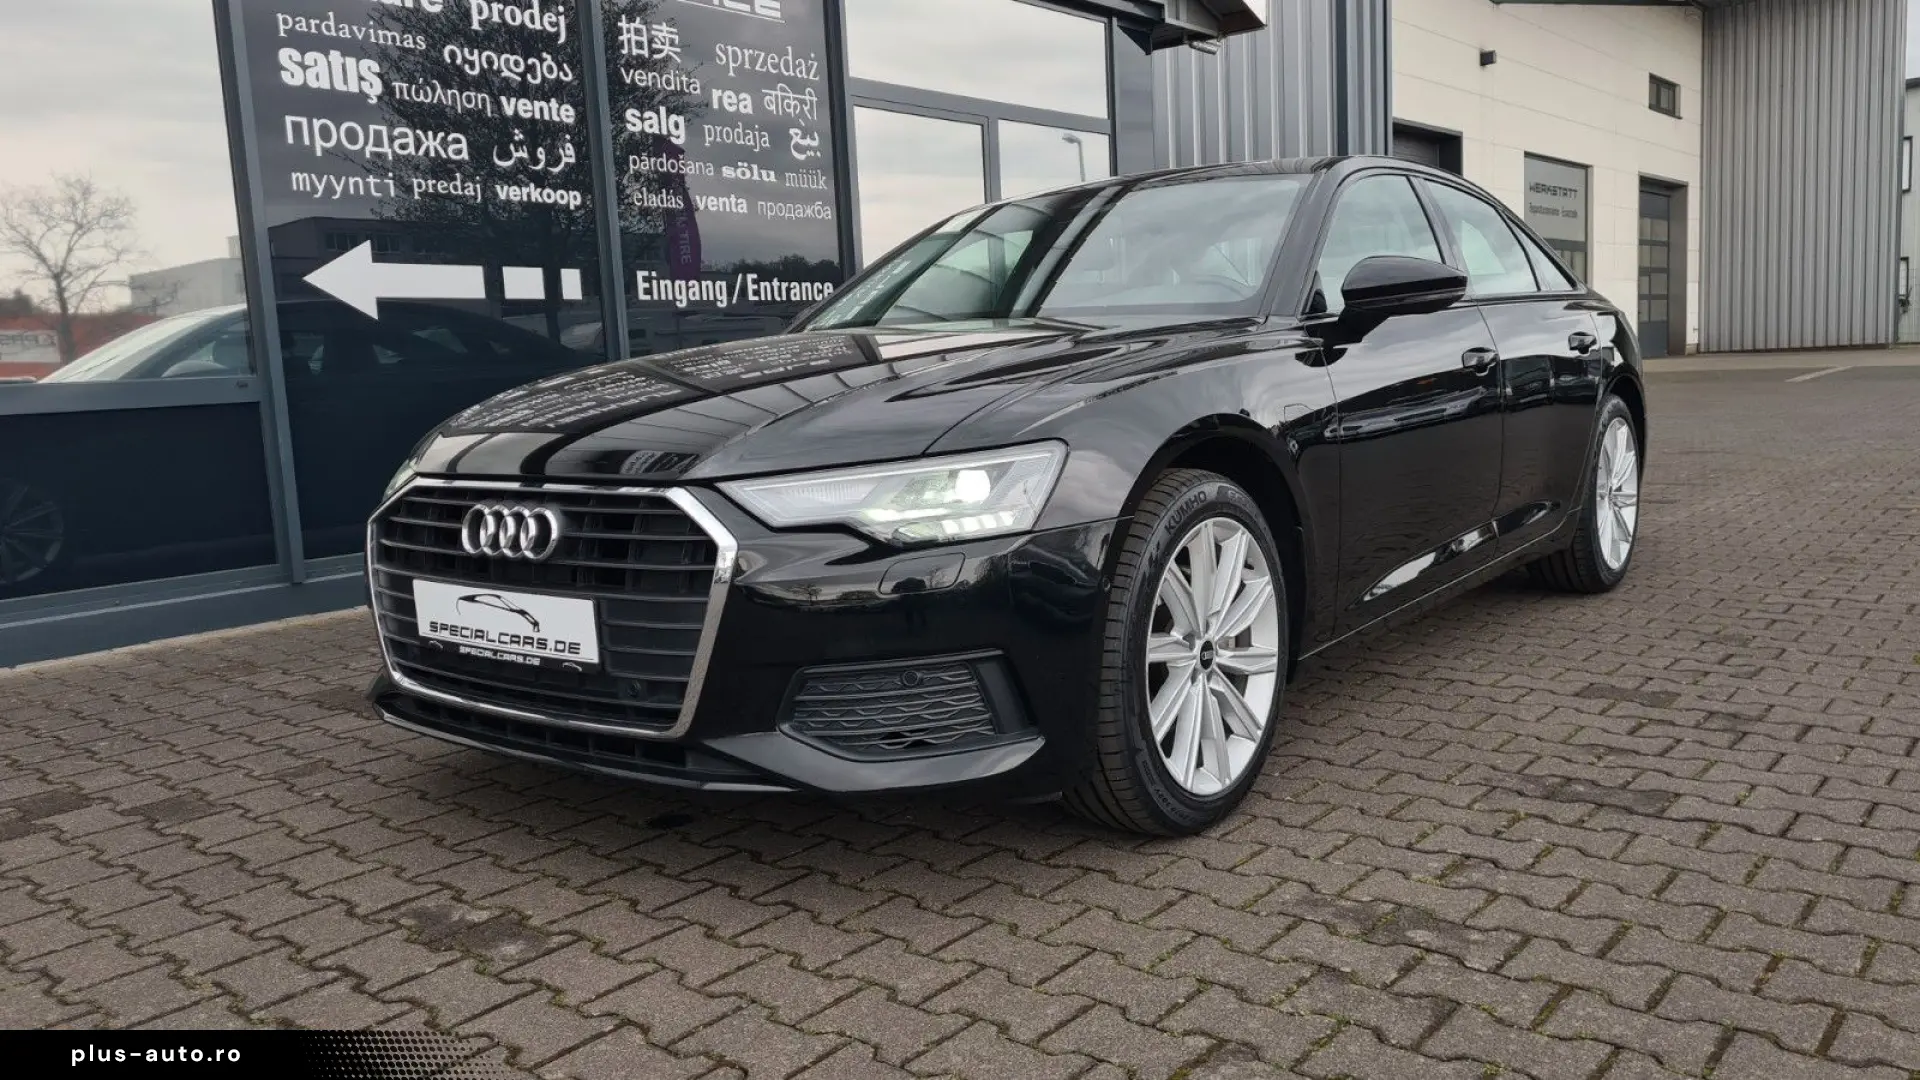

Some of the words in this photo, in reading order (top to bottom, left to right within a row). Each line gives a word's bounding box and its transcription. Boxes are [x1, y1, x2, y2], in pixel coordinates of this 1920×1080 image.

[276, 12, 426, 50] pardavimas
[471, 0, 566, 44] prodej
[617, 14, 682, 63] 拍卖
[278, 47, 383, 104] satış
[715, 42, 820, 81] sprzedaż
[620, 67, 701, 95] vendita
[391, 77, 492, 117] πώληση
[499, 96, 576, 124] vente
[712, 87, 753, 114] rea
[284, 115, 469, 160] продажа
[624, 106, 686, 145] salg
[703, 122, 771, 152] prodaja
[492, 128, 576, 172] فروش
[629, 152, 714, 177] pārdošana
[291, 171, 395, 199] myynti
[721, 162, 777, 182] sölu
[785, 169, 828, 190] müük
[412, 174, 482, 203] predaj
[496, 184, 582, 209] verkoop
[633, 187, 684, 209] eladás
[696, 194, 748, 213] venta
[757, 200, 832, 221] продажба
[636, 270, 728, 308] Eingang
[746, 273, 835, 302] Entrance
[1164, 490, 1207, 536] KUMHO
[429, 621, 582, 655] SPECIALCARS.DE
